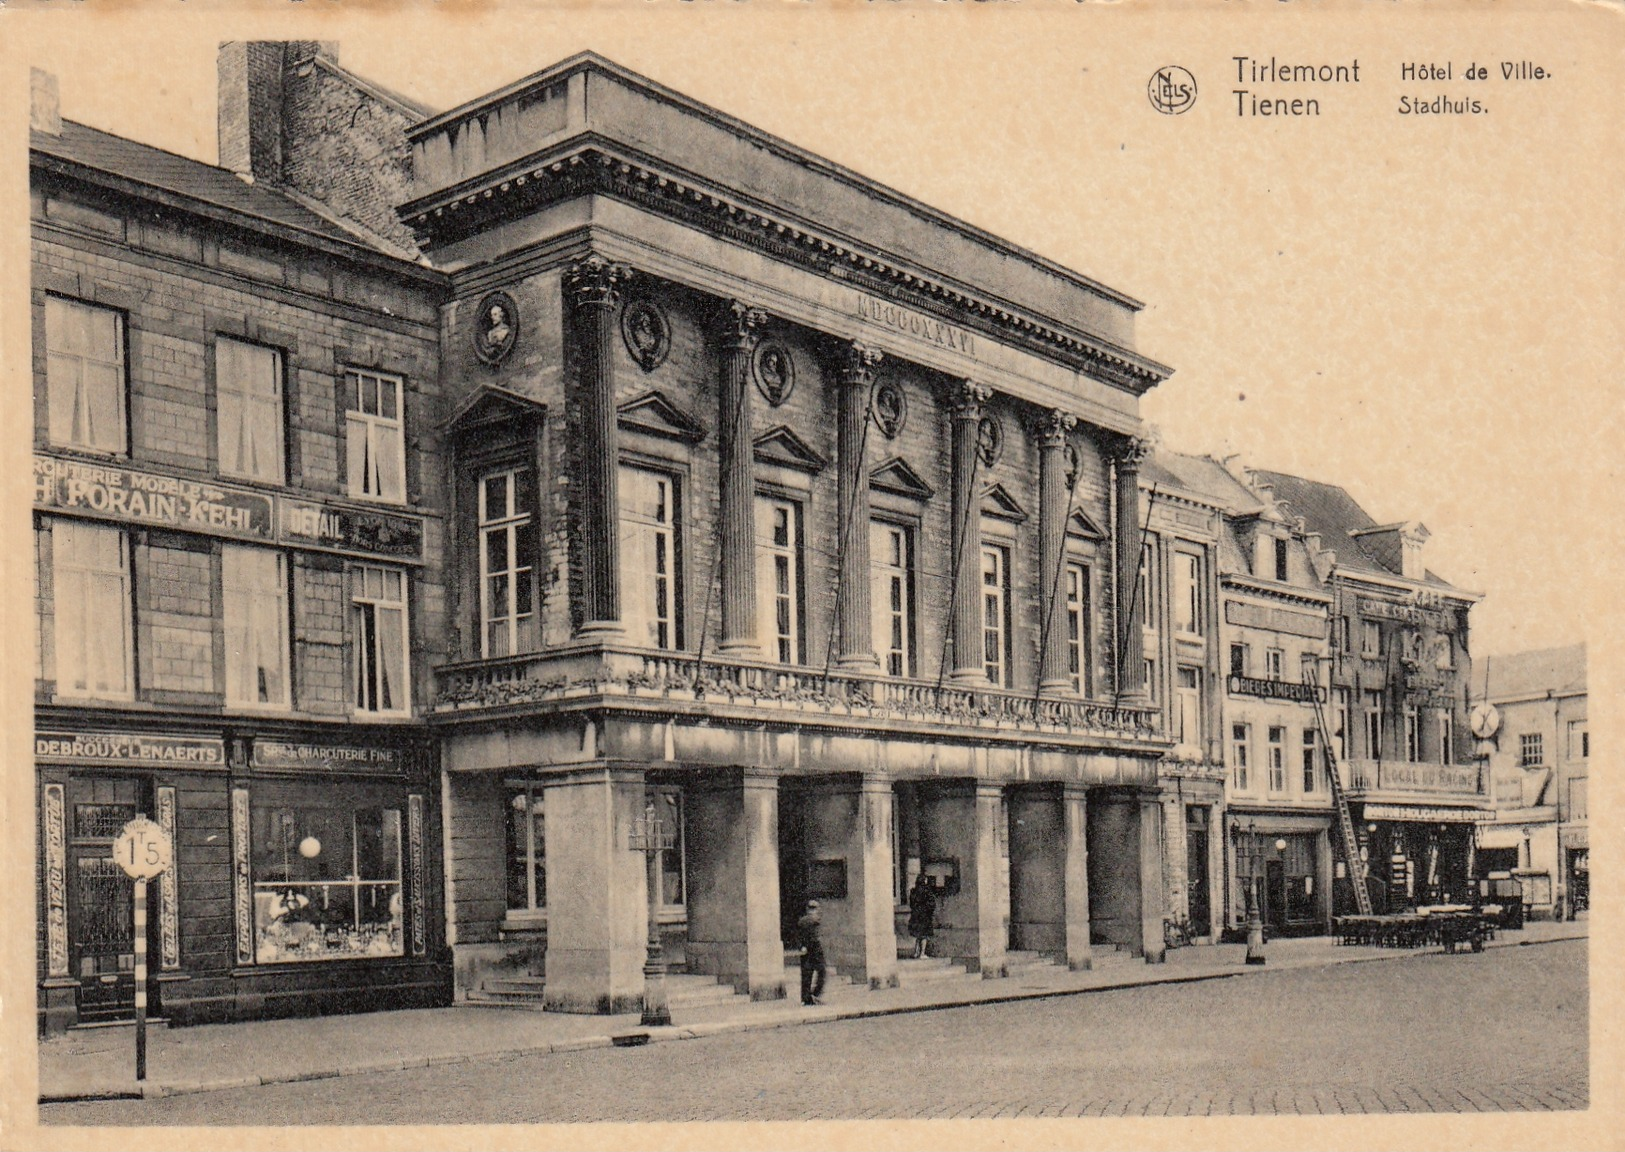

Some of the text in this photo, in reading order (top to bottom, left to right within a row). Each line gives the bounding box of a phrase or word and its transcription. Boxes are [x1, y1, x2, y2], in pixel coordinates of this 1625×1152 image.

[37, 740, 217, 762] DEBROUX-LENAERTS
[298, 747, 367, 761] CHARCUTERIE
[370, 750, 393, 762] FINE
